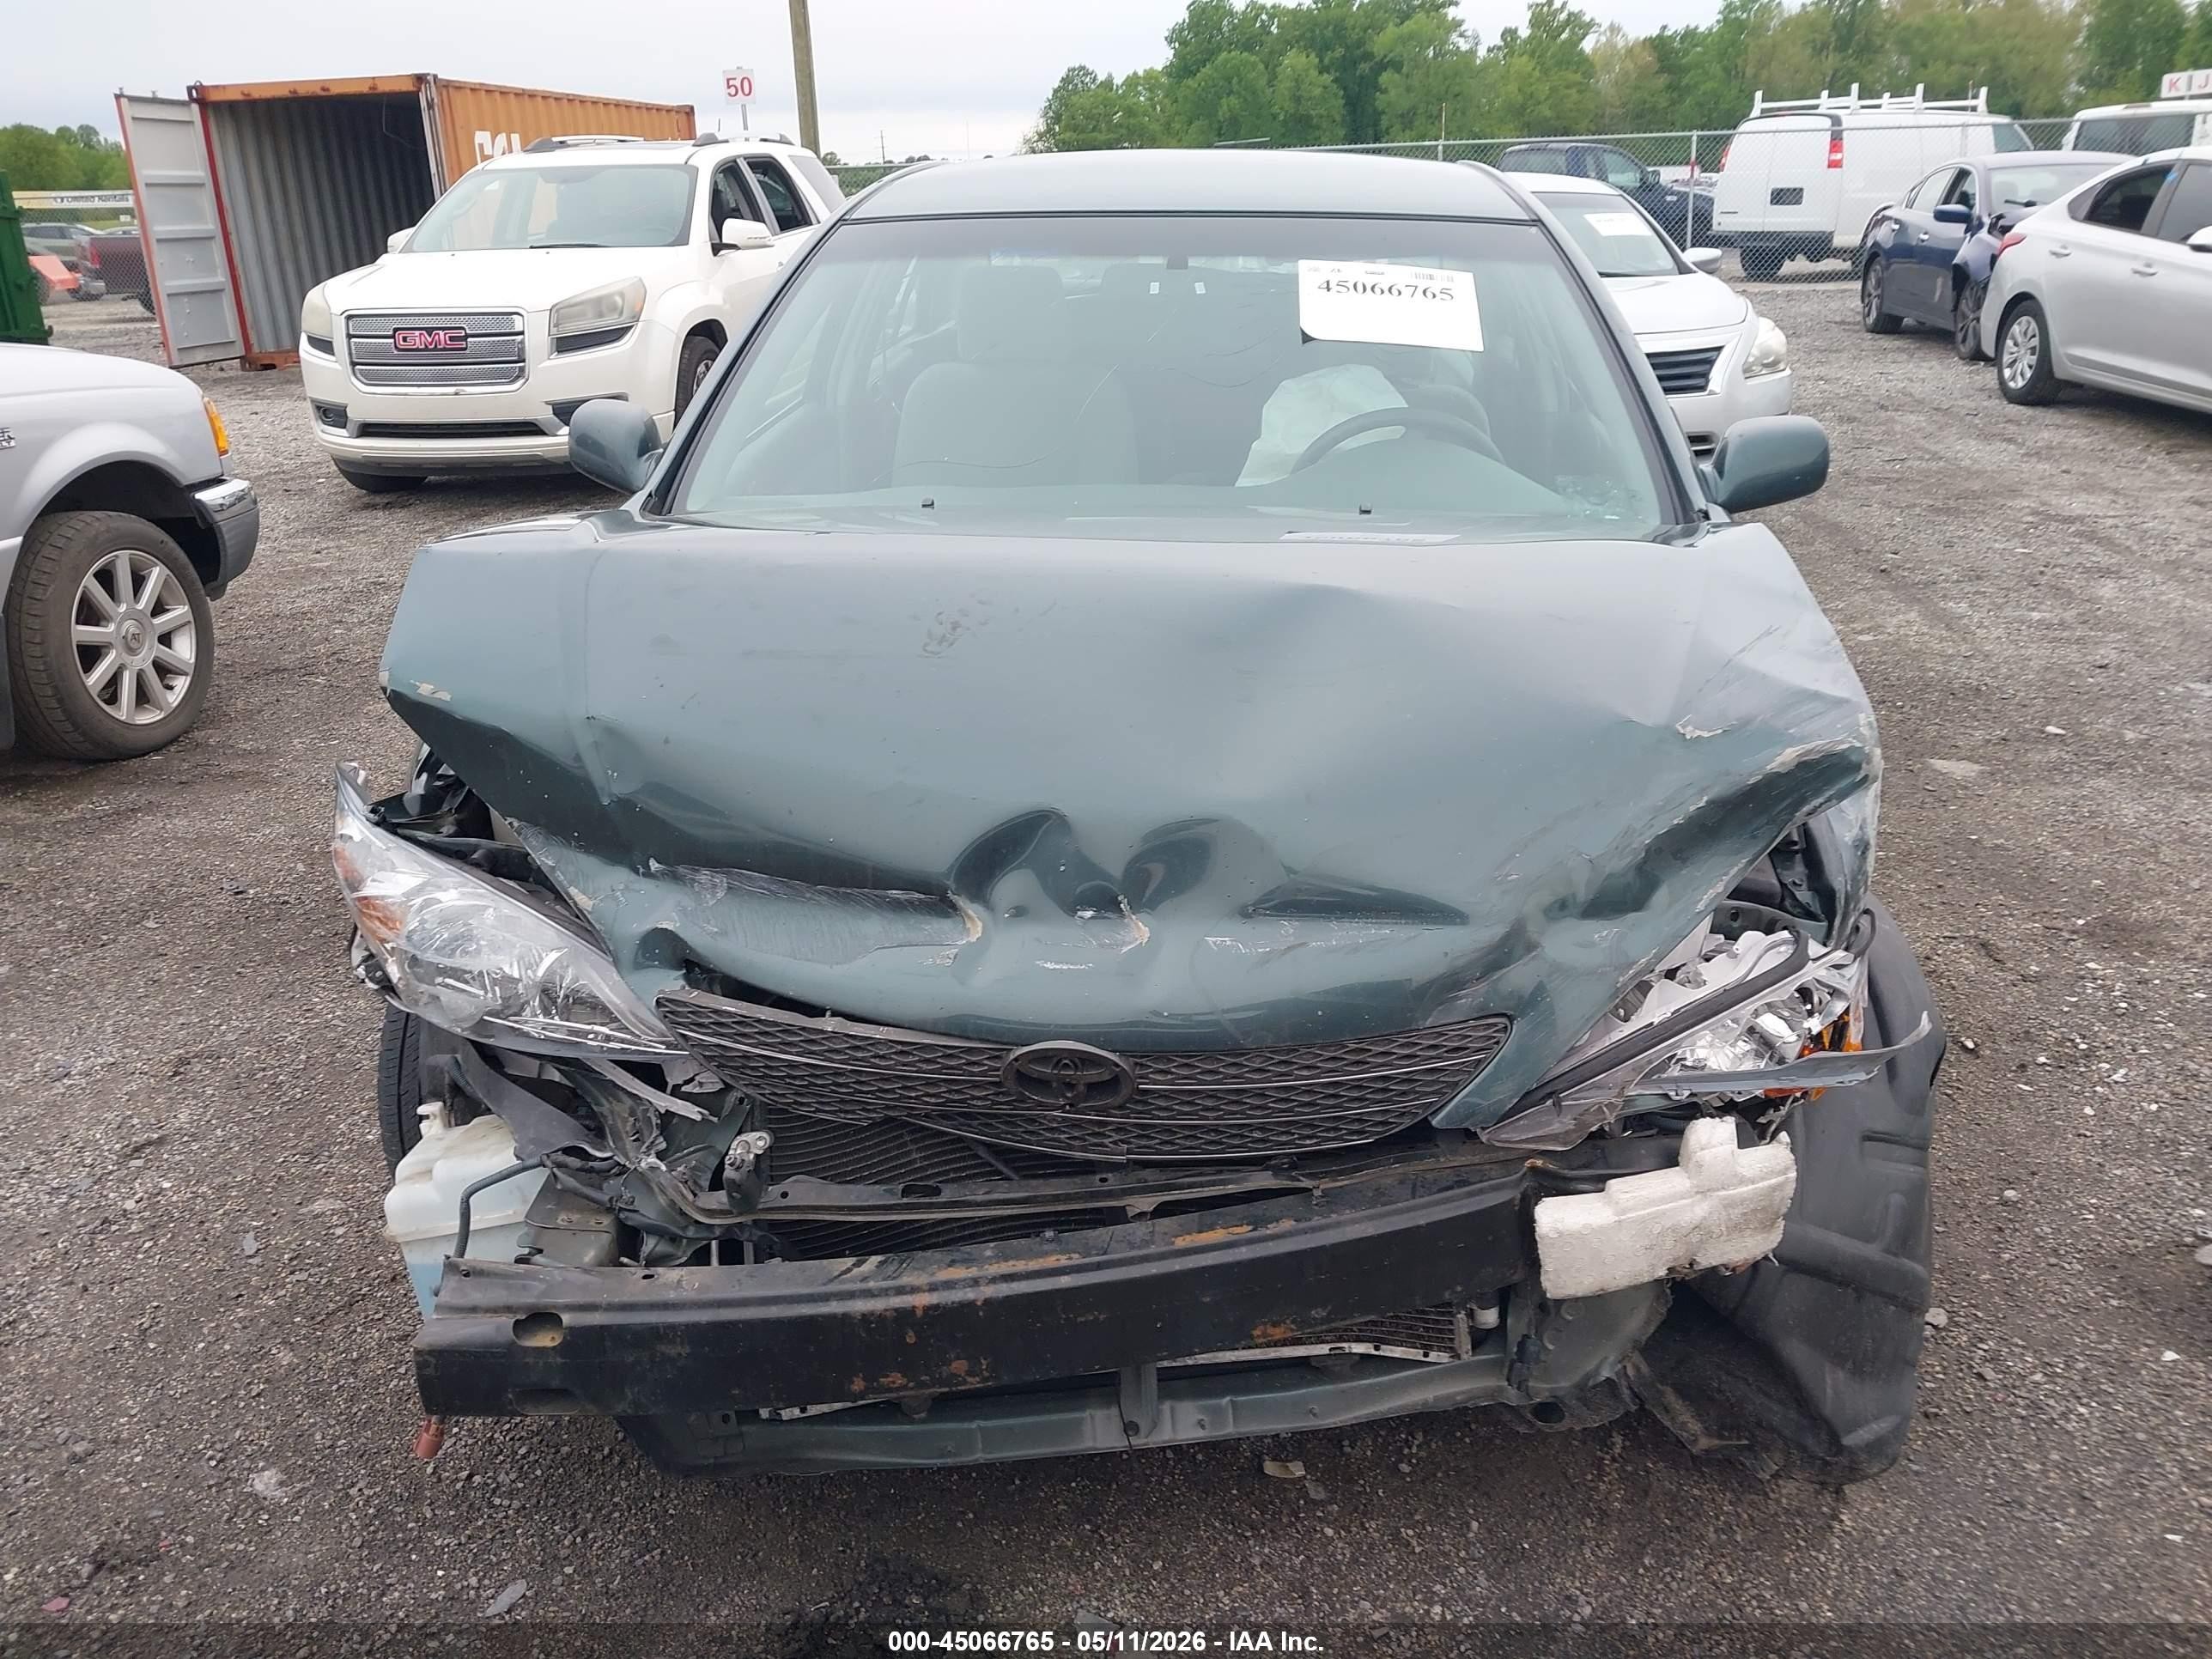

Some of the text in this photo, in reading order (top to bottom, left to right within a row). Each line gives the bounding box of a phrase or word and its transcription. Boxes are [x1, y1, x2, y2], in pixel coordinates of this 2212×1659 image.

[726, 76, 753, 98] 50
[1317, 279, 1455, 301] 45066765
[395, 330, 466, 349] GMC
